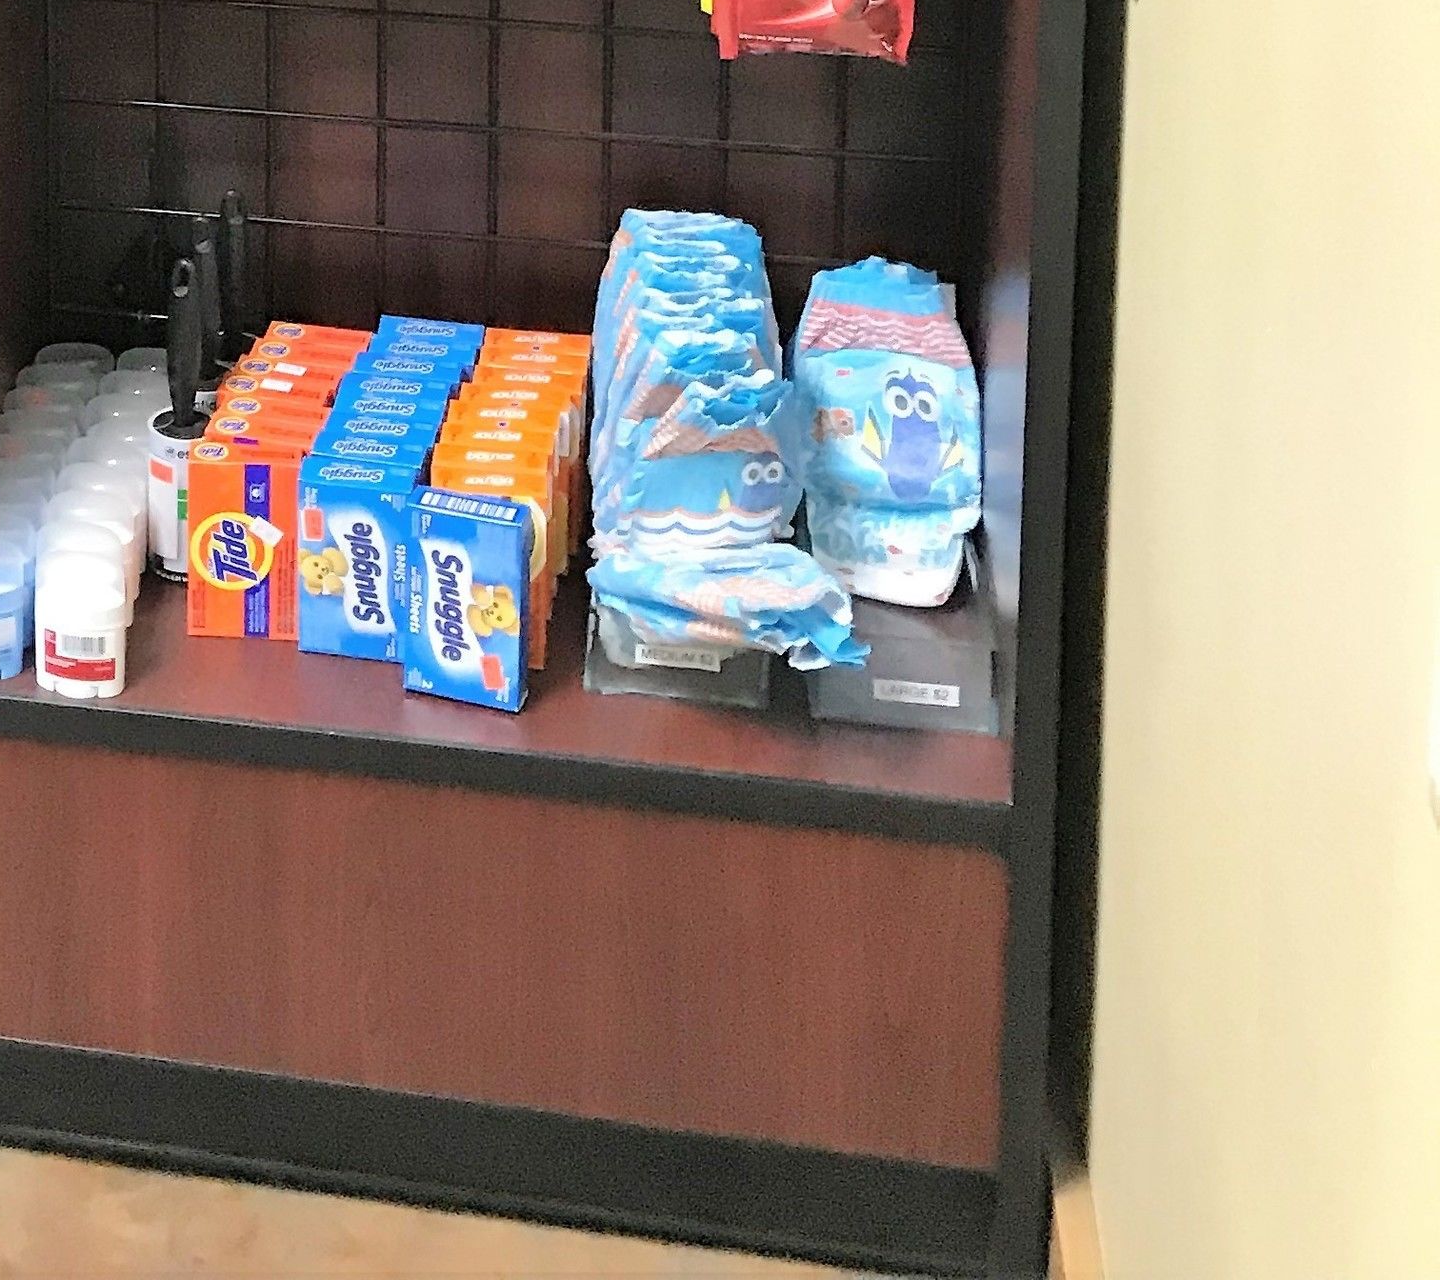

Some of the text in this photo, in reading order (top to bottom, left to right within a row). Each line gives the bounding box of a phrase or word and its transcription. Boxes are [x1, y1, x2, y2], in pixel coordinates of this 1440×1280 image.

[389, 343, 447, 354] Snuggle
[373, 360, 433, 372] Snuggle
[362, 379, 420, 393] Snuggle
[355, 399, 415, 414] Snuggle
[346, 421, 407, 434] Snuggle
[334, 441, 396, 455] Snuggle
[321, 467, 383, 481] Snuggle
[212, 519, 259, 582] Tide
[393, 544, 407, 583] Sheets
[344, 522, 386, 625] Snuggle
[431, 549, 471, 662] Snuggle
[410, 592, 422, 635] Sheets
[878, 684, 928, 700] LARGE
